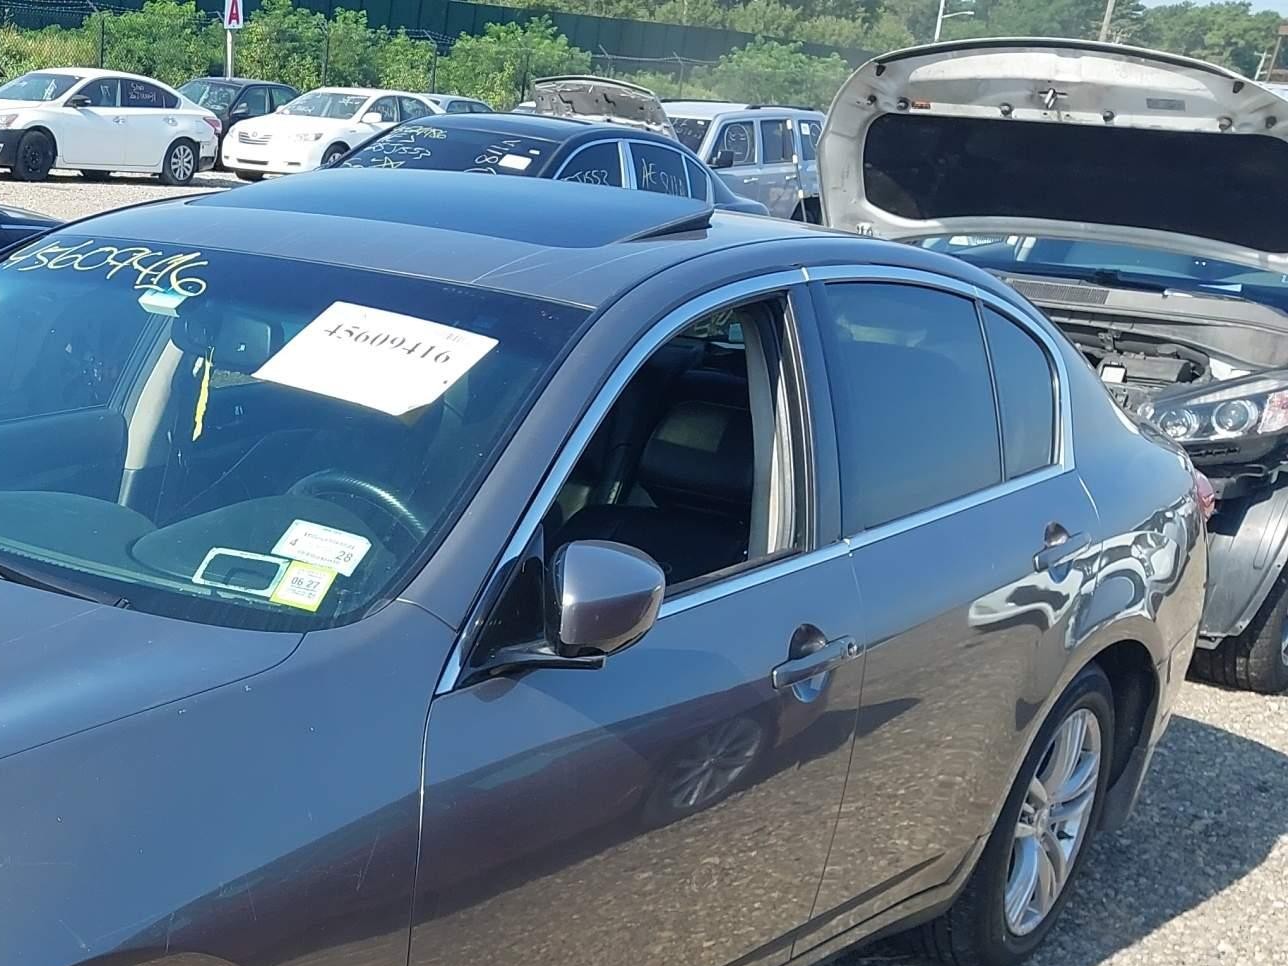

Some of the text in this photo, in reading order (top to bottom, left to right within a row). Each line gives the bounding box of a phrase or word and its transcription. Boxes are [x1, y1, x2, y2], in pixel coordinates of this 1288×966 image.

[228, 0, 240, 25] A
[2, 240, 209, 297] 45609416
[323, 323, 452, 364] 45609416
[335, 550, 354, 564] 28
[306, 579, 321, 590] 27
